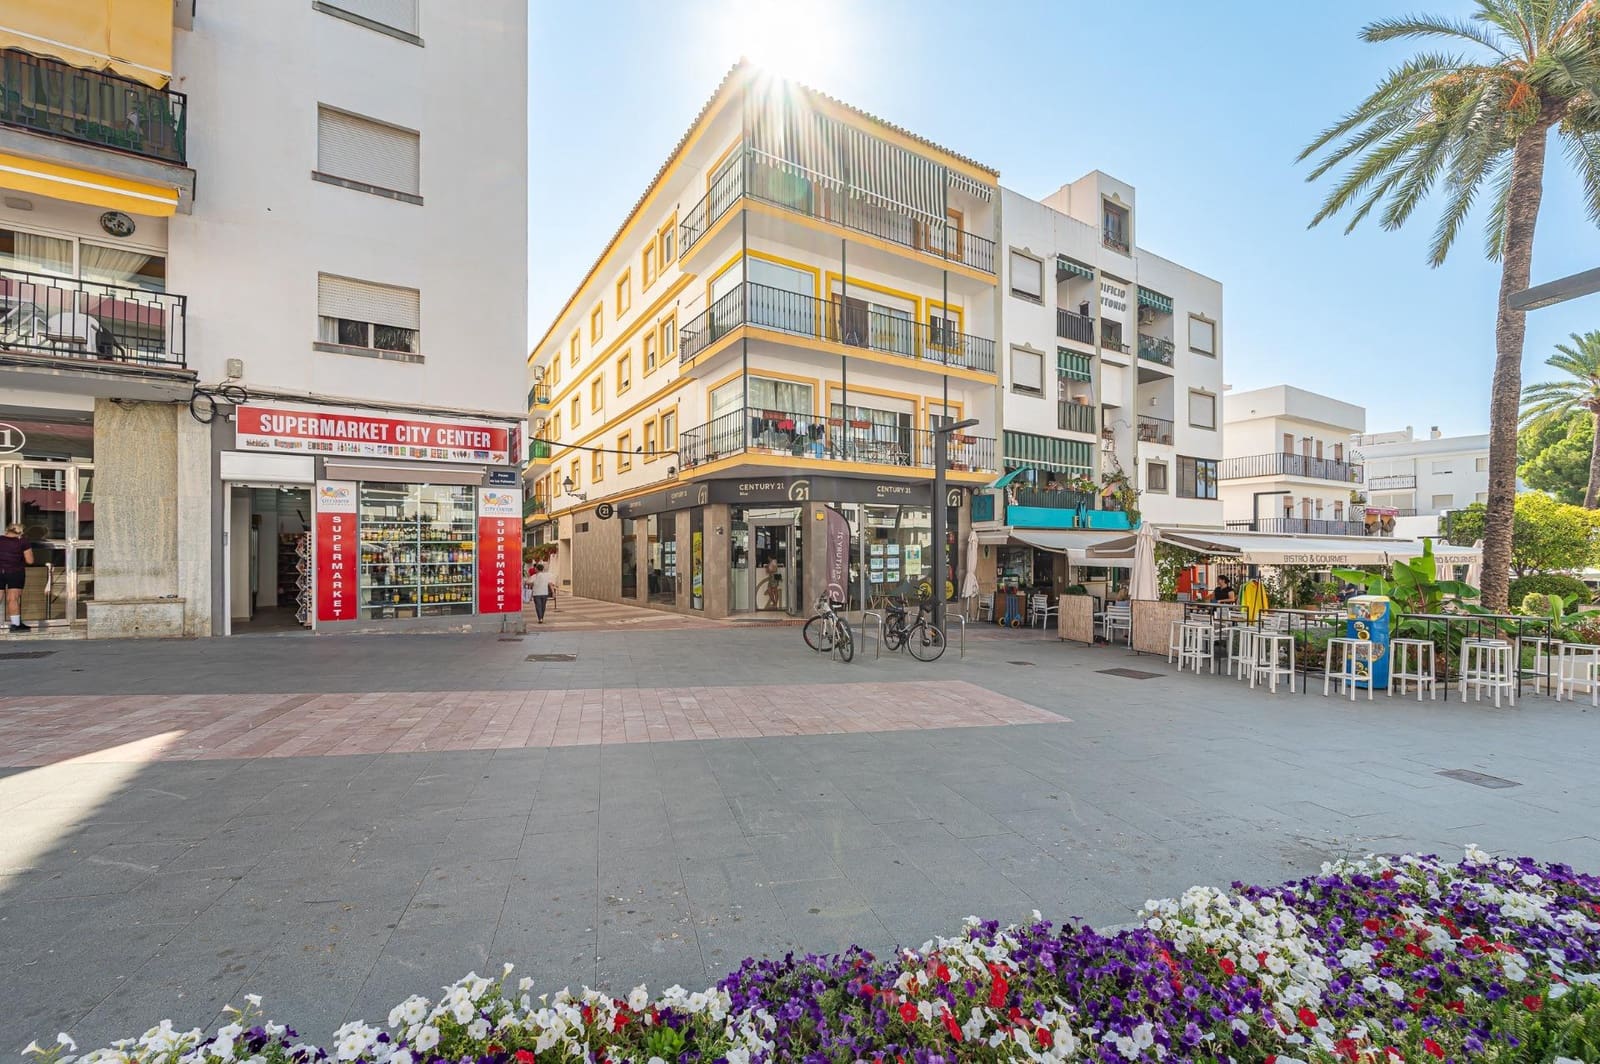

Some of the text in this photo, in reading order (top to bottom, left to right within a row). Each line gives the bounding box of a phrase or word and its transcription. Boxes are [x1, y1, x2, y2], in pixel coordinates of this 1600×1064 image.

[260, 414, 389, 440] SUPERMARKET
[395, 424, 431, 444] CITY
[437, 428, 491, 448] CENTER
[738, 482, 785, 491] CENTURY 21
[876, 485, 904, 494] CENTURY
[701, 490, 707, 505] 21
[795, 487, 809, 501] 21
[951, 495, 961, 507] 21
[496, 520, 506, 610] SUPERMARKET
[1309, 554, 1315, 563] &
[1315, 554, 1348, 563] GOURMET
[331, 515, 343, 617] SUPERMARKET
